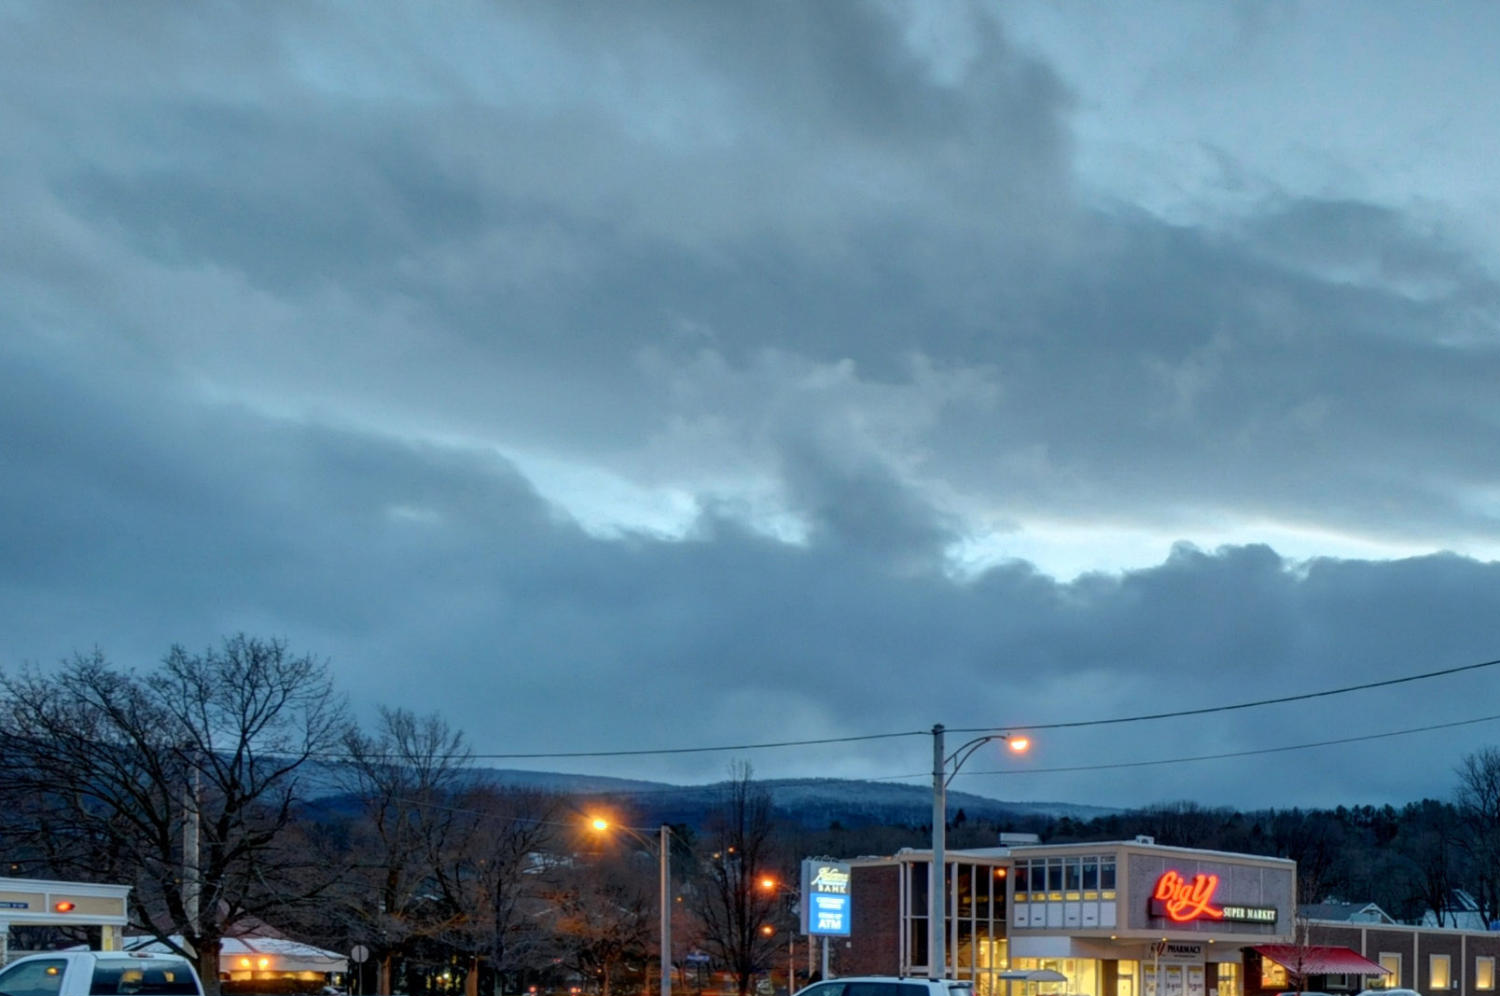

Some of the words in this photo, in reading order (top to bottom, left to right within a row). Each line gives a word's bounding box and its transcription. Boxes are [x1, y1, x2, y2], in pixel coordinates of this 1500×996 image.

[818, 885, 847, 894] BANK
[1223, 907, 1245, 918] SUPER
[1247, 908, 1276, 920] MARKET
[818, 919, 842, 929] ATM
[1167, 944, 1201, 954] PHARMACY
